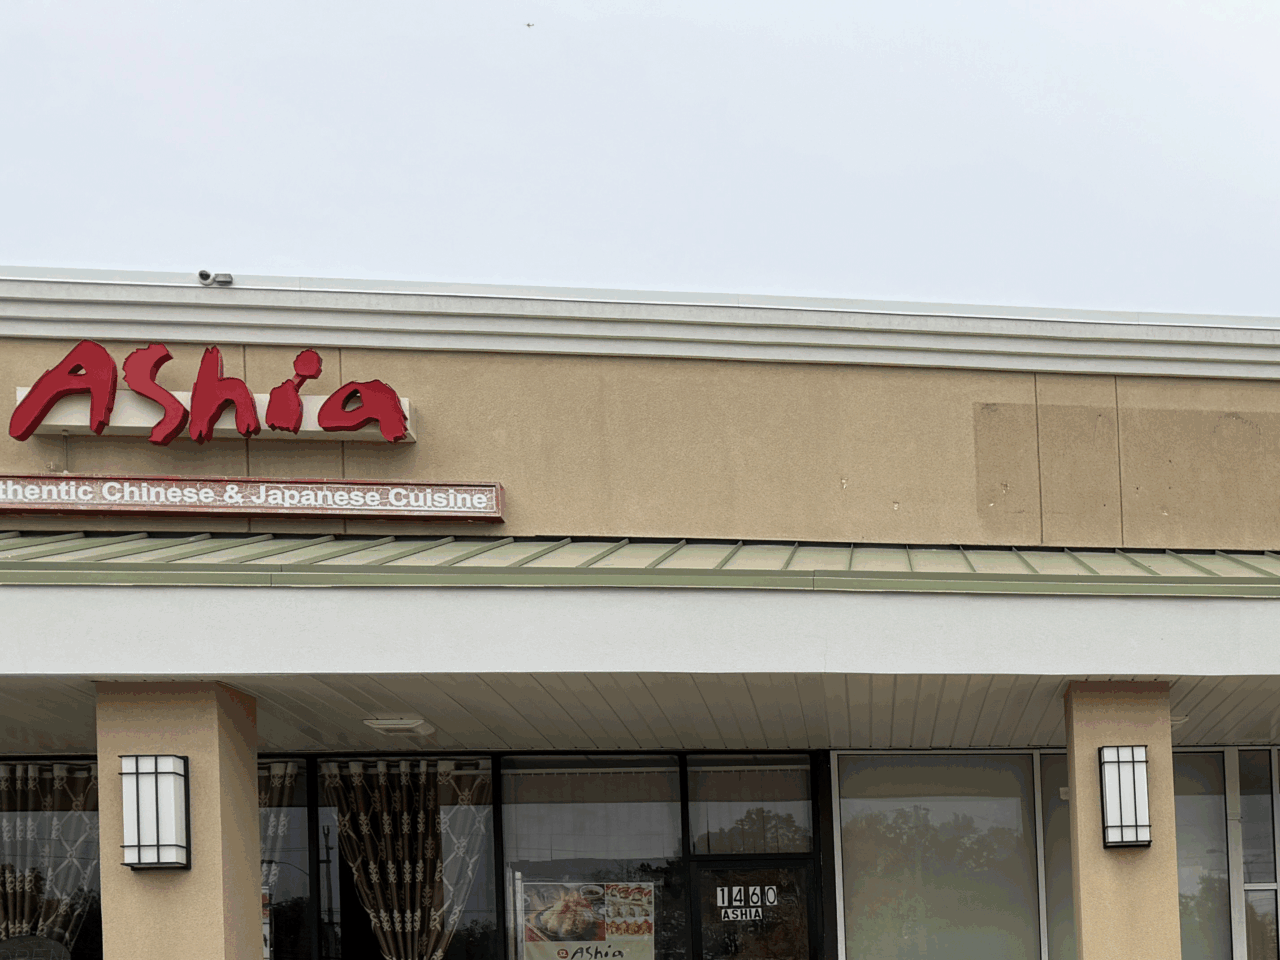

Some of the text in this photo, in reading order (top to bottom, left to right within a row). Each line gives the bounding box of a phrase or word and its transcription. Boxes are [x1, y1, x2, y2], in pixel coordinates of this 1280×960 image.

[102, 482, 214, 502] Chinese
[223, 485, 242, 503] &
[251, 486, 380, 507] Japanese
[388, 488, 487, 508] Cuisine
[719, 887, 776, 905] 1460
[722, 909, 762, 919] ASHIA
